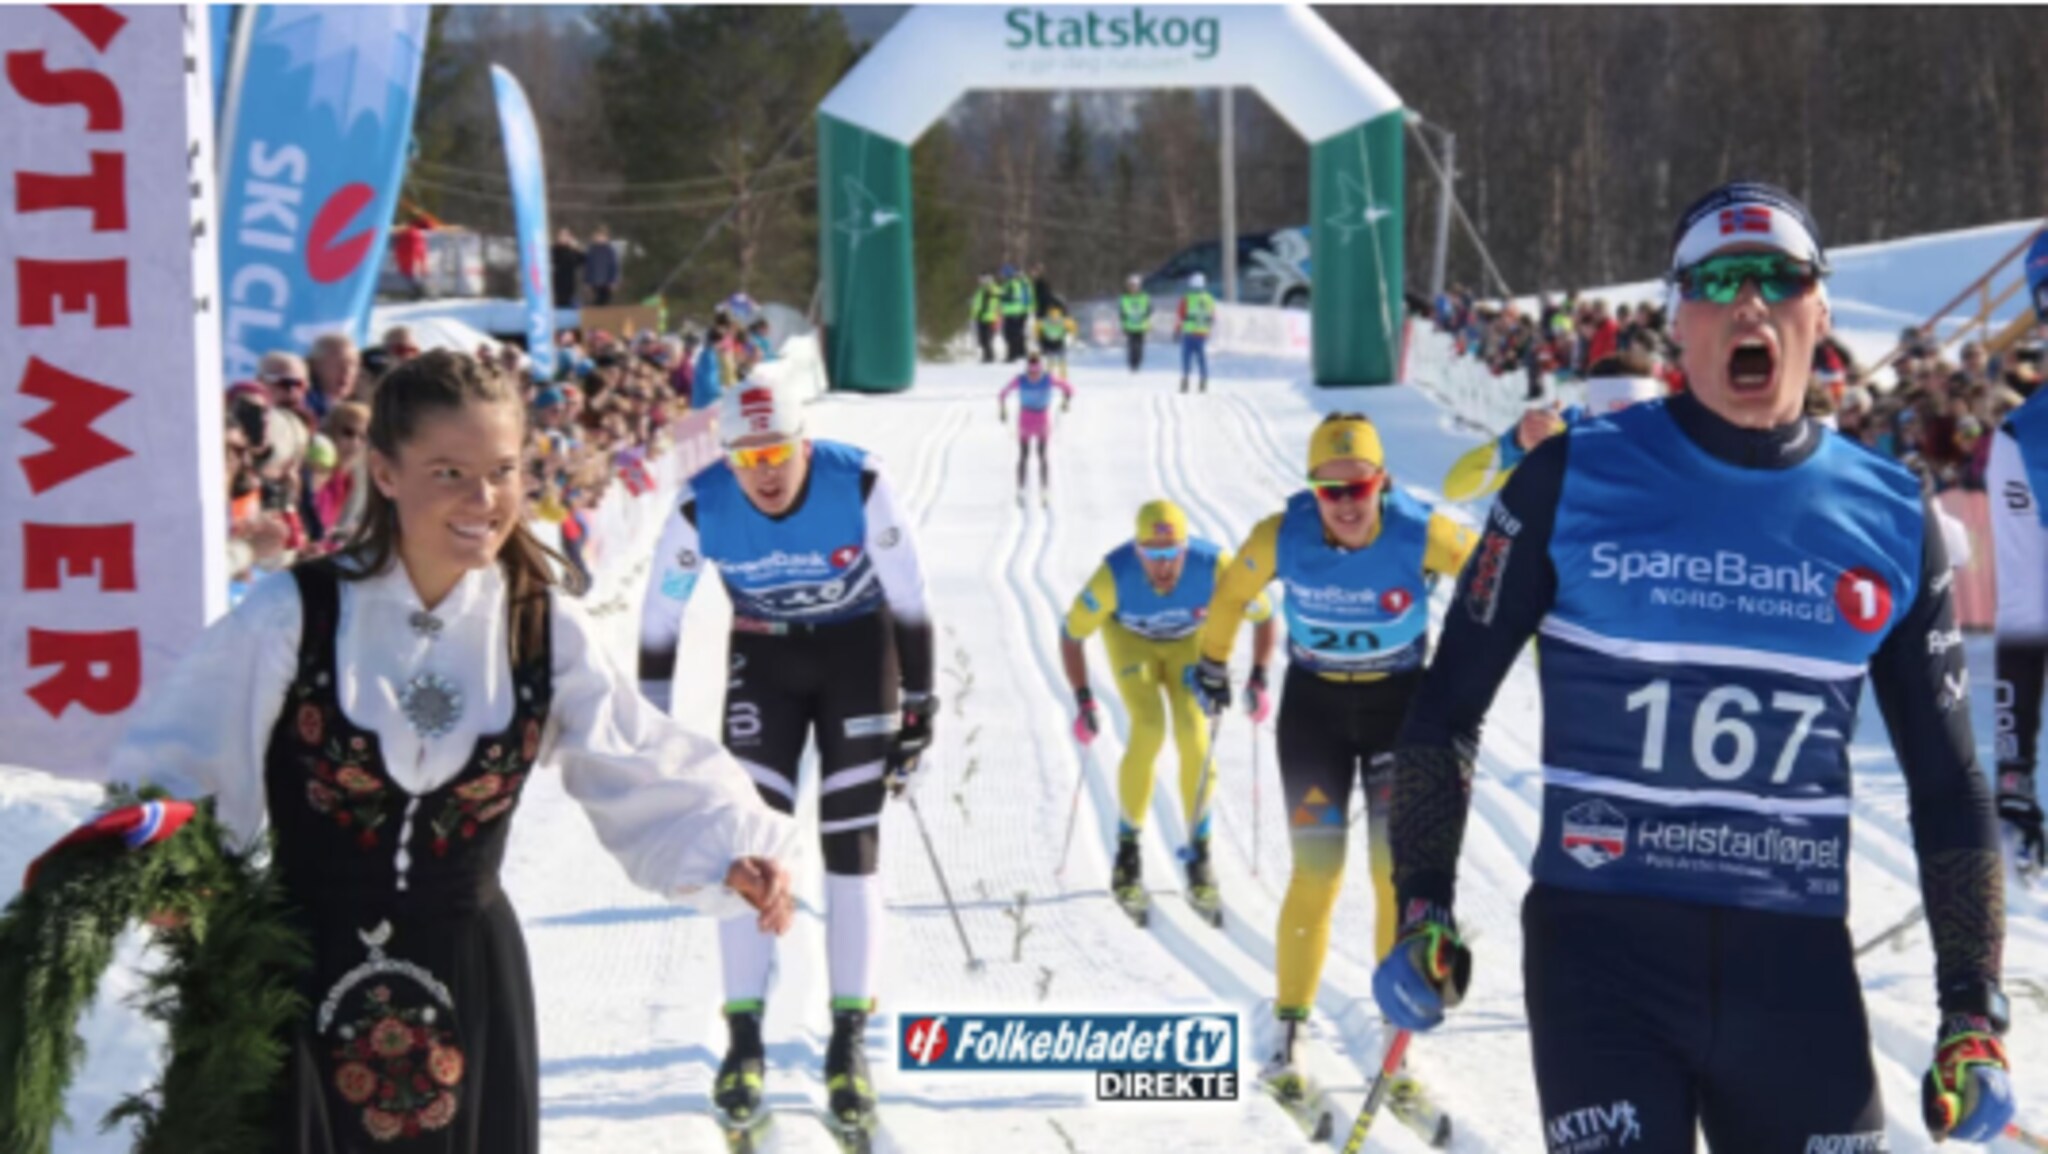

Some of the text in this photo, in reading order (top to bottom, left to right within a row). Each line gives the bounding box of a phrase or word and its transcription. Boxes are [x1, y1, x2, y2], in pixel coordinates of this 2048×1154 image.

[1004, 7, 1220, 59] Statskog
[238, 140, 308, 253] SKI
[1589, 542, 1827, 597] SpareBank
[1626, 679, 1826, 784] 167
